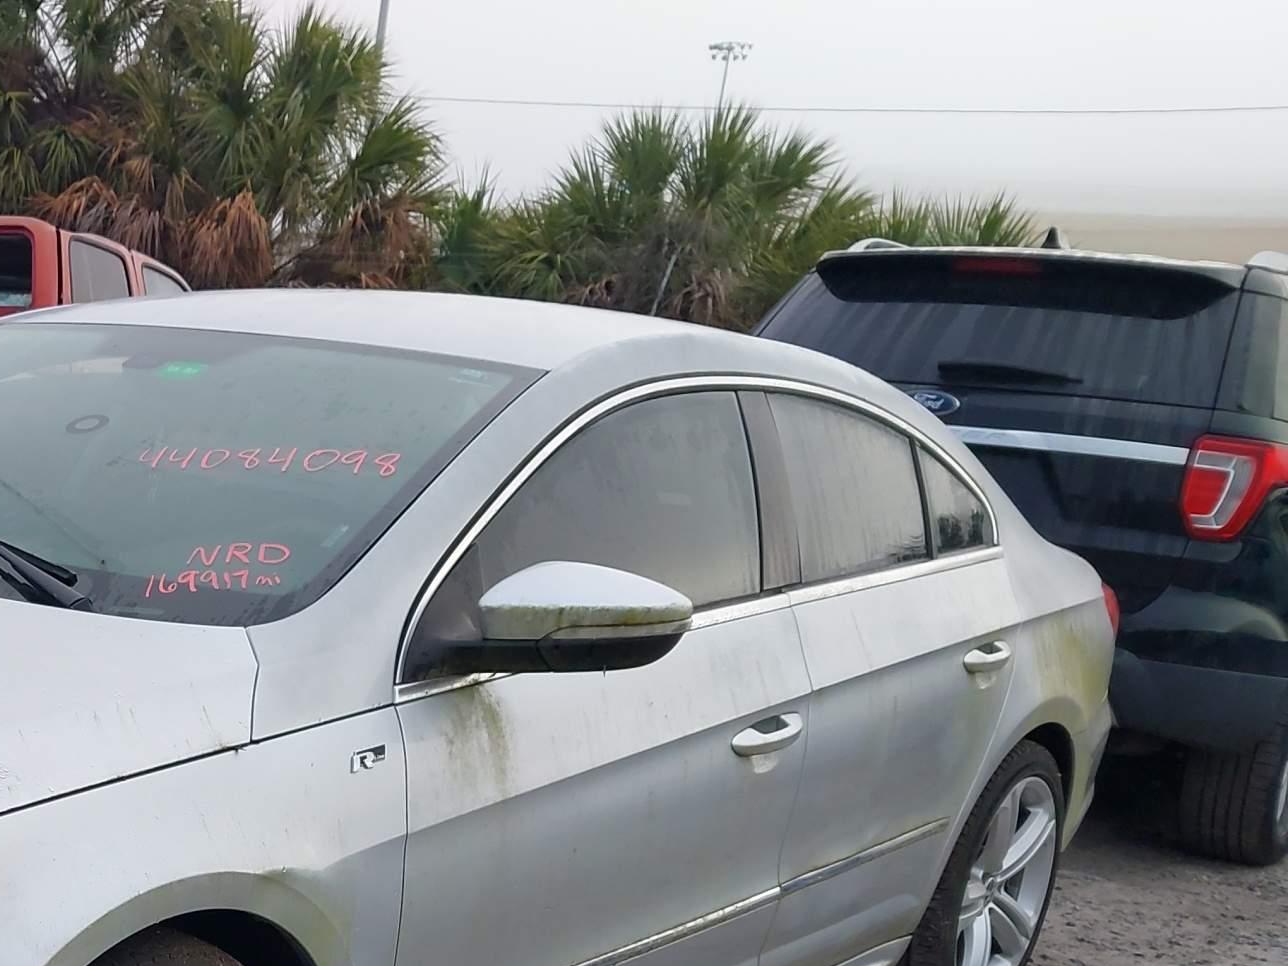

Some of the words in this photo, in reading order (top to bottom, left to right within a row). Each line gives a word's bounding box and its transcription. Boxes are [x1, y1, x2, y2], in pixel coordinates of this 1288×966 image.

[138, 446, 402, 477] 44084098
[186, 542, 292, 567] NRD
[144, 568, 250, 598] 169917
